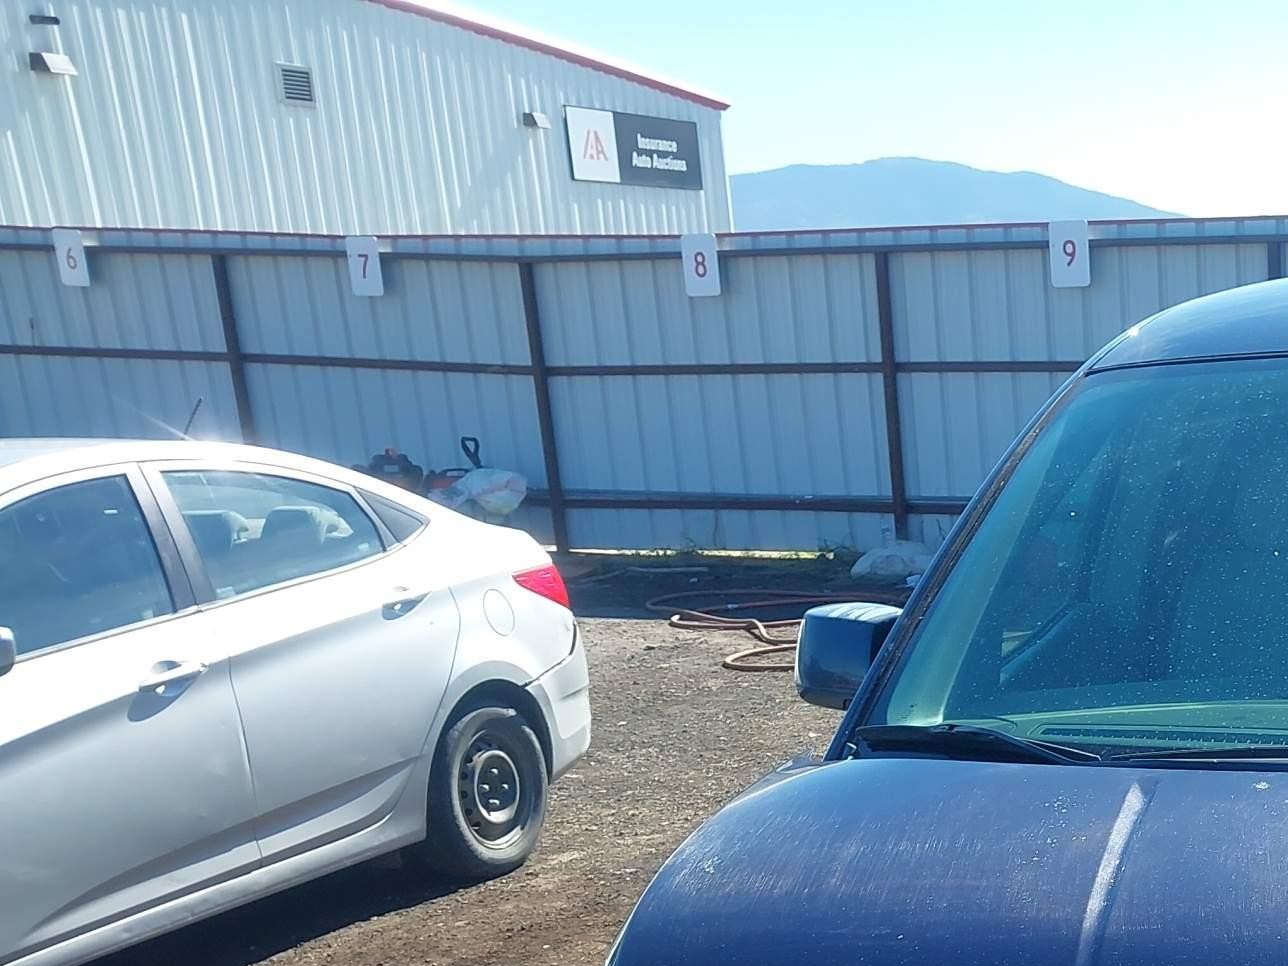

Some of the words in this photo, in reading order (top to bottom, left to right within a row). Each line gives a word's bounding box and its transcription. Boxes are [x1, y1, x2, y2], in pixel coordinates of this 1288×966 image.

[637, 133, 678, 152] Insurance
[632, 151, 652, 169] Auto
[653, 153, 687, 172] Auctions
[66, 247, 77, 270] 6
[694, 251, 707, 278] 8
[1063, 239, 1076, 267] 9
[357, 253, 369, 279] 7
